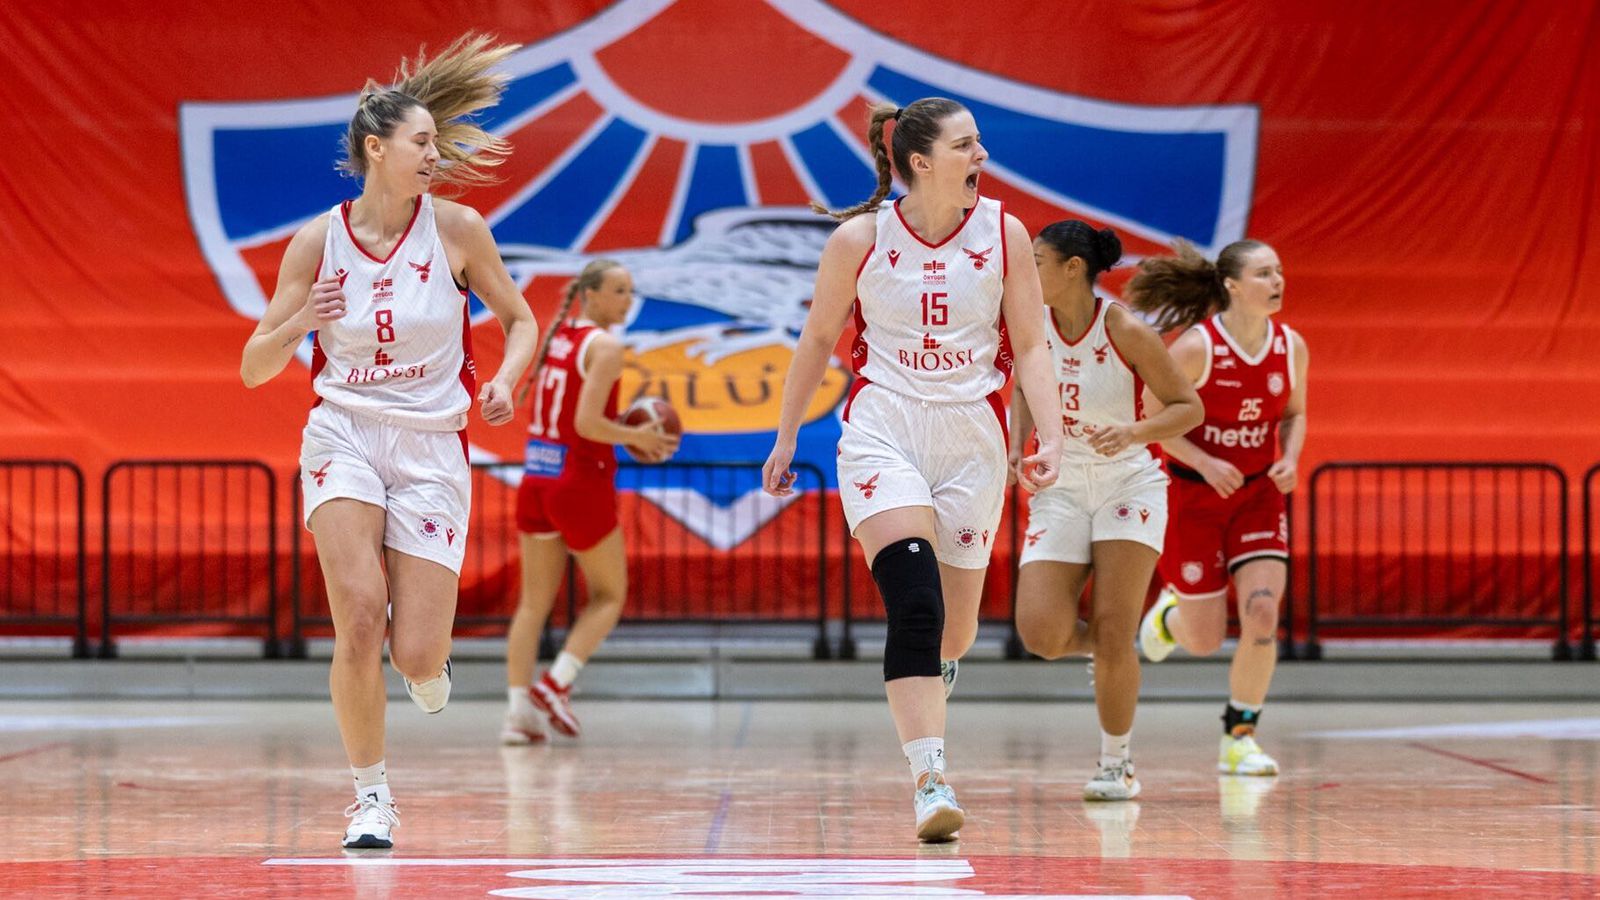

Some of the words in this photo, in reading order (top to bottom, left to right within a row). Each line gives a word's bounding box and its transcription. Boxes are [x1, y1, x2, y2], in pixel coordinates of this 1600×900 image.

[375, 309, 396, 343] 8
[920, 292, 948, 326] 15
[527, 364, 568, 440] 17
[1238, 398, 1263, 421] 25
